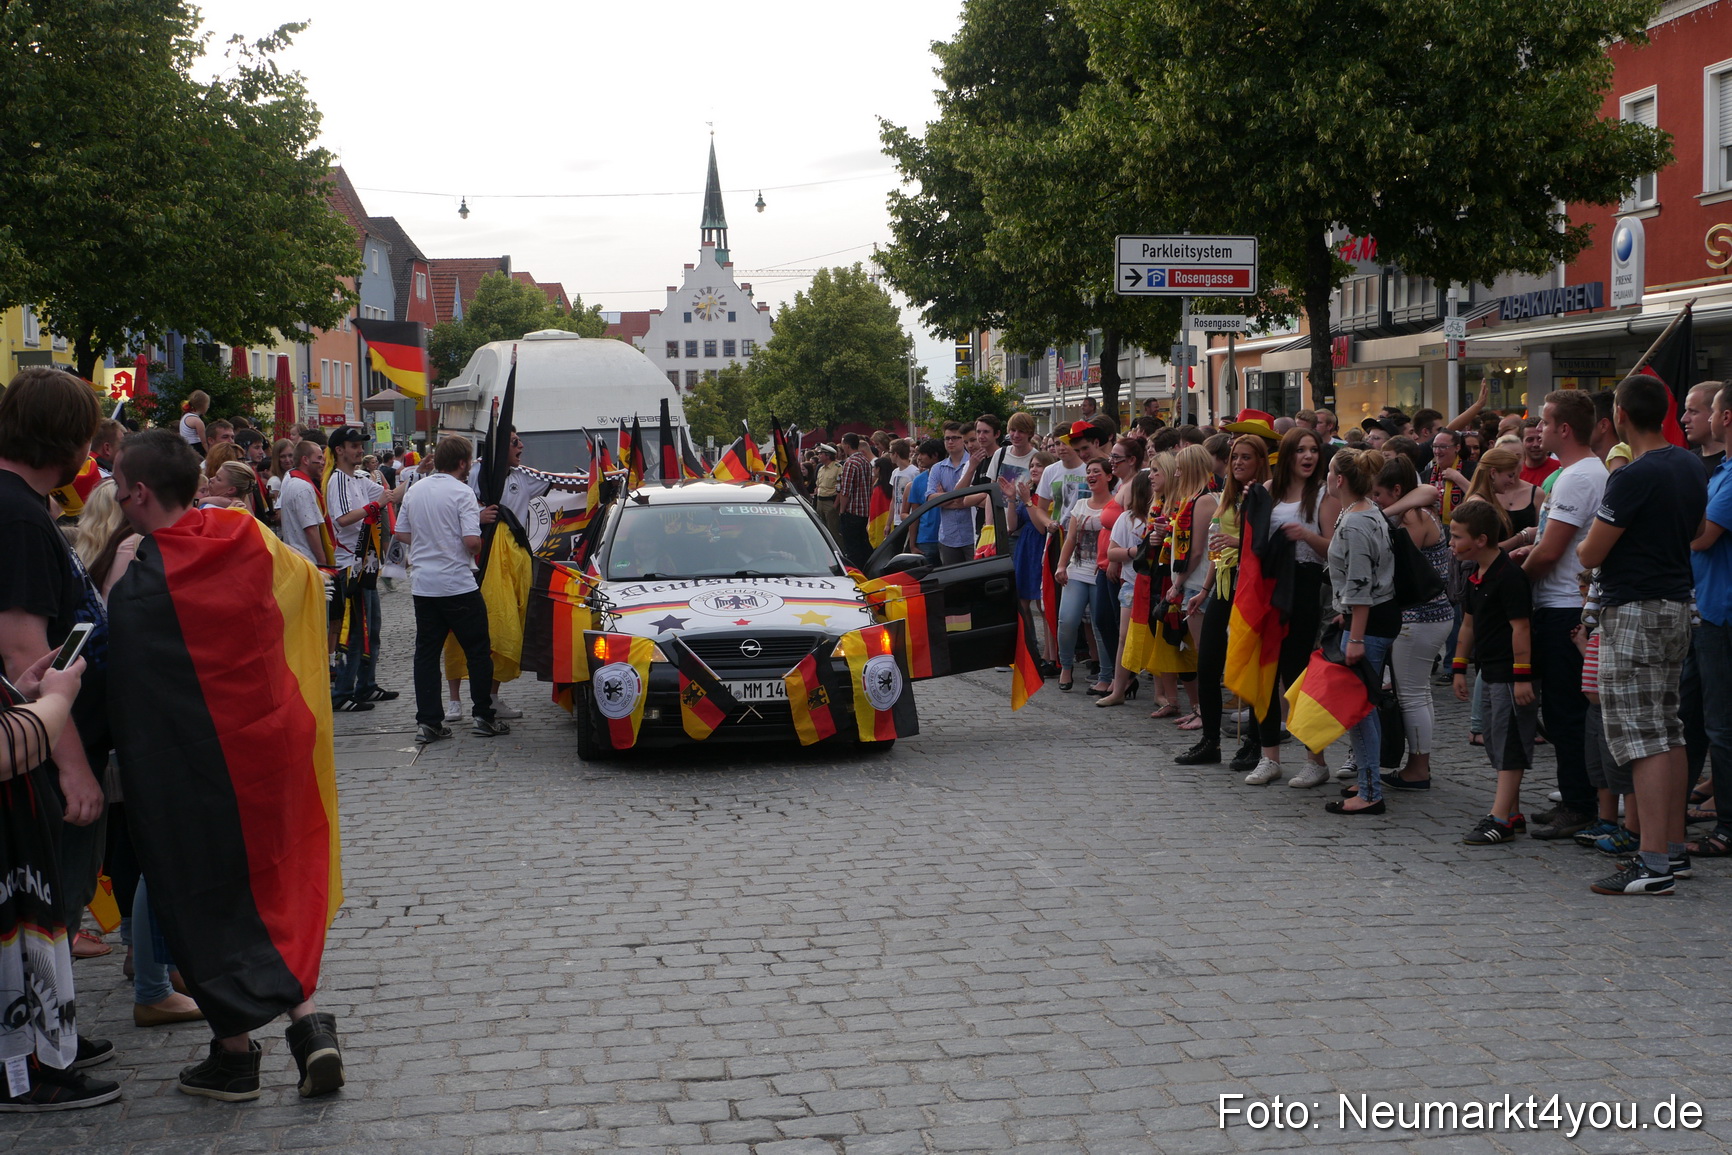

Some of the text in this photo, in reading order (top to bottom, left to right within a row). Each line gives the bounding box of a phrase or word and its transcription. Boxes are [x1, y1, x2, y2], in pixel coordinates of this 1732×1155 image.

[1142, 243, 1232, 261] Parkleitsystem
[1175, 271, 1234, 287] Rosengasse
[1615, 273, 1633, 286] PRESSE
[1194, 317, 1240, 330] Rosengasse
[609, 414, 679, 424] WEISBEG
[739, 505, 788, 516] BOMBA
[744, 682, 763, 699] MM
[766, 682, 788, 698] 14
